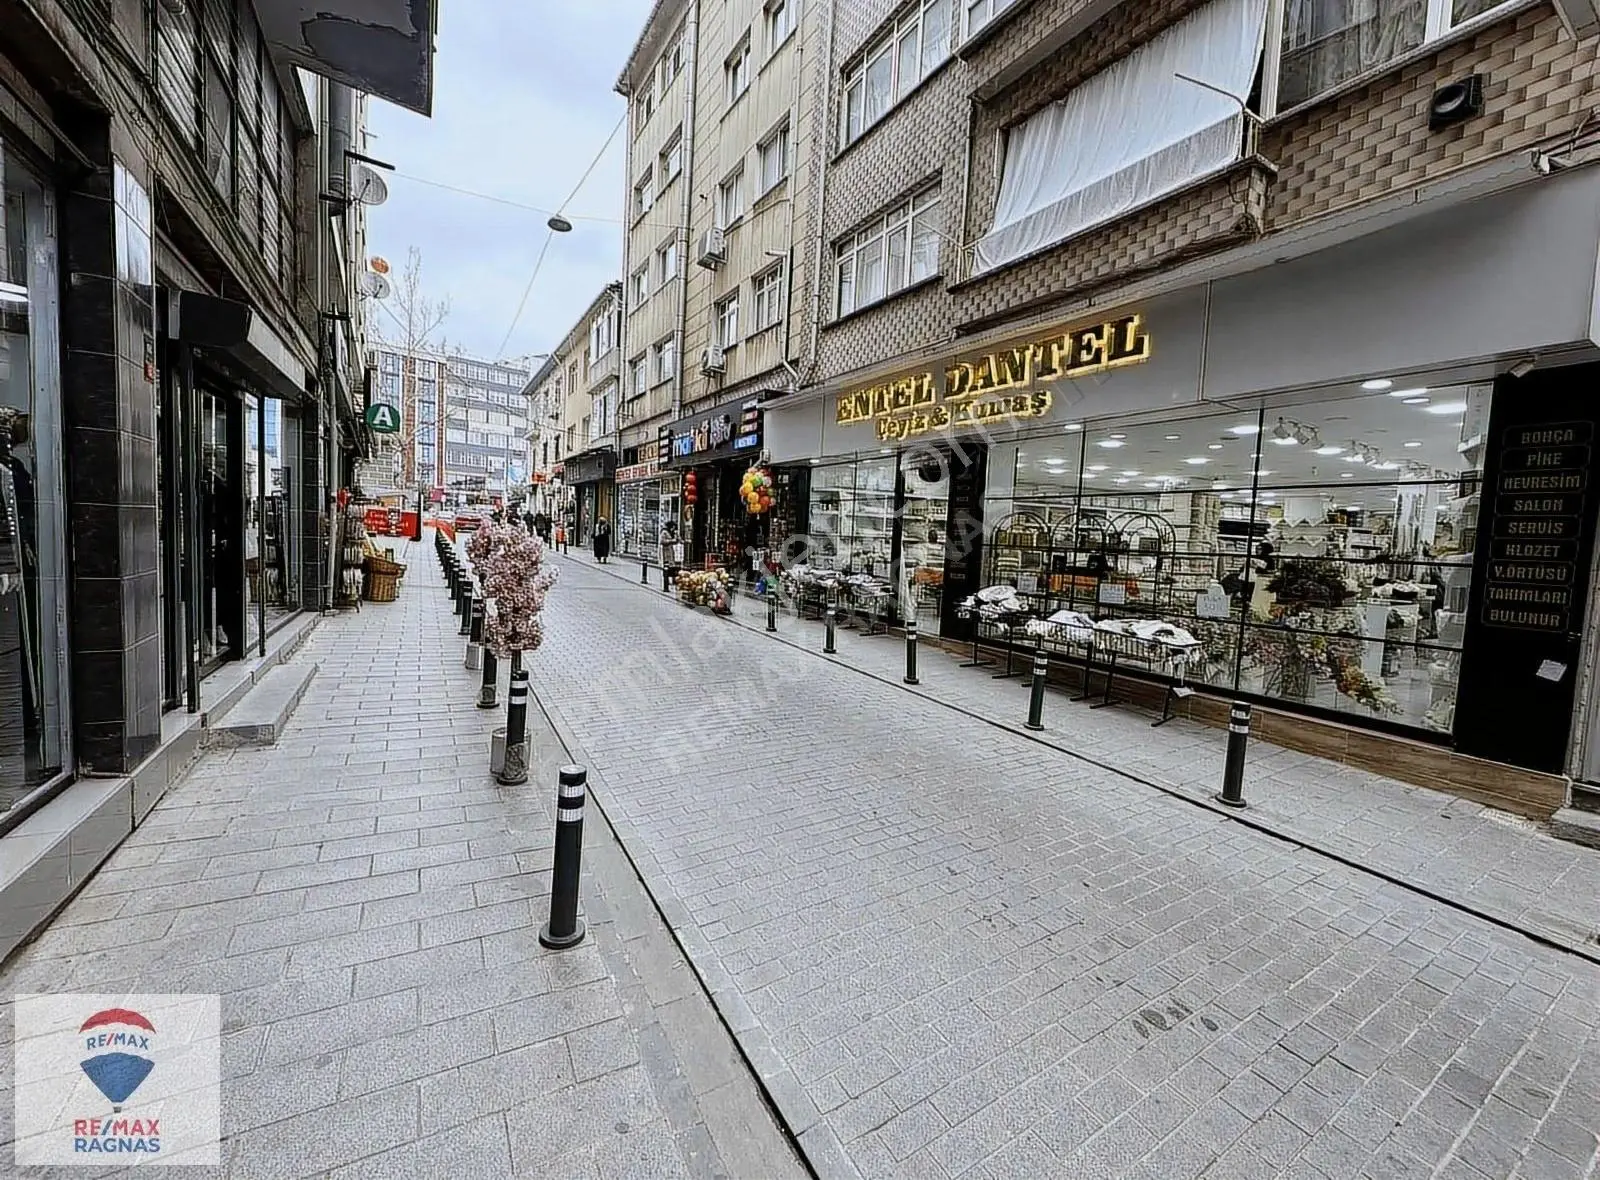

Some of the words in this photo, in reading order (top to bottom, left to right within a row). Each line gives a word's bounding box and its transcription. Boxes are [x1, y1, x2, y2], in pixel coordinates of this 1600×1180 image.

[836, 373, 936, 423] ENTEL
[944, 313, 1151, 400] DANTEL
[373, 404, 393, 426] A
[928, 409, 948, 429] &
[1521, 428, 1574, 445] BOHÇA
[1527, 452, 1562, 467] PİKE
[1504, 474, 1580, 489] NEVRESİM
[1514, 499, 1563, 512] SALON
[1508, 521, 1564, 535] SERVİS
[1489, 587, 1567, 604] TAKIMLARI
[1490, 609, 1560, 627] BULUNUR
